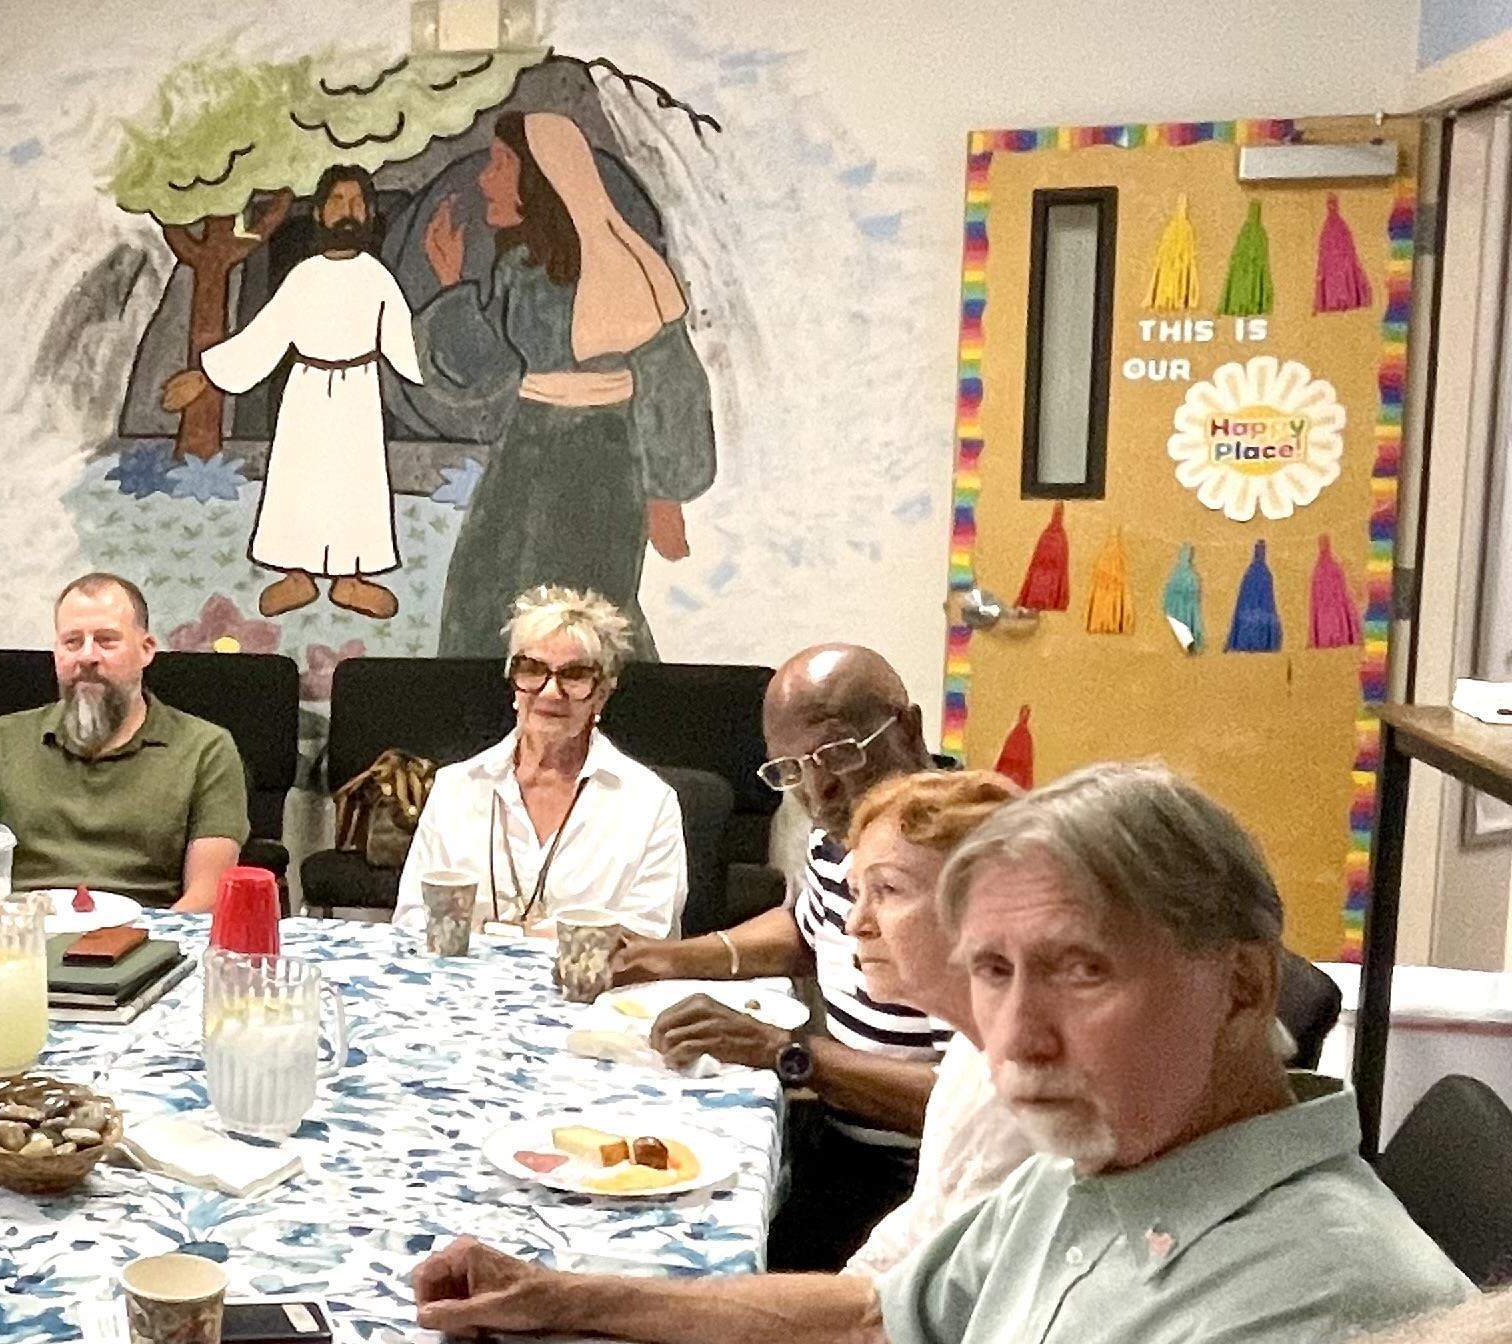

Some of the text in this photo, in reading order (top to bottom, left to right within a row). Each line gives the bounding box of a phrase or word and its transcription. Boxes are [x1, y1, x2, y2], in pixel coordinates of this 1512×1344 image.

[1138, 318, 1268, 342] THIS IS
[1122, 357, 1192, 381] OUR
[1210, 417, 1305, 441] Happy
